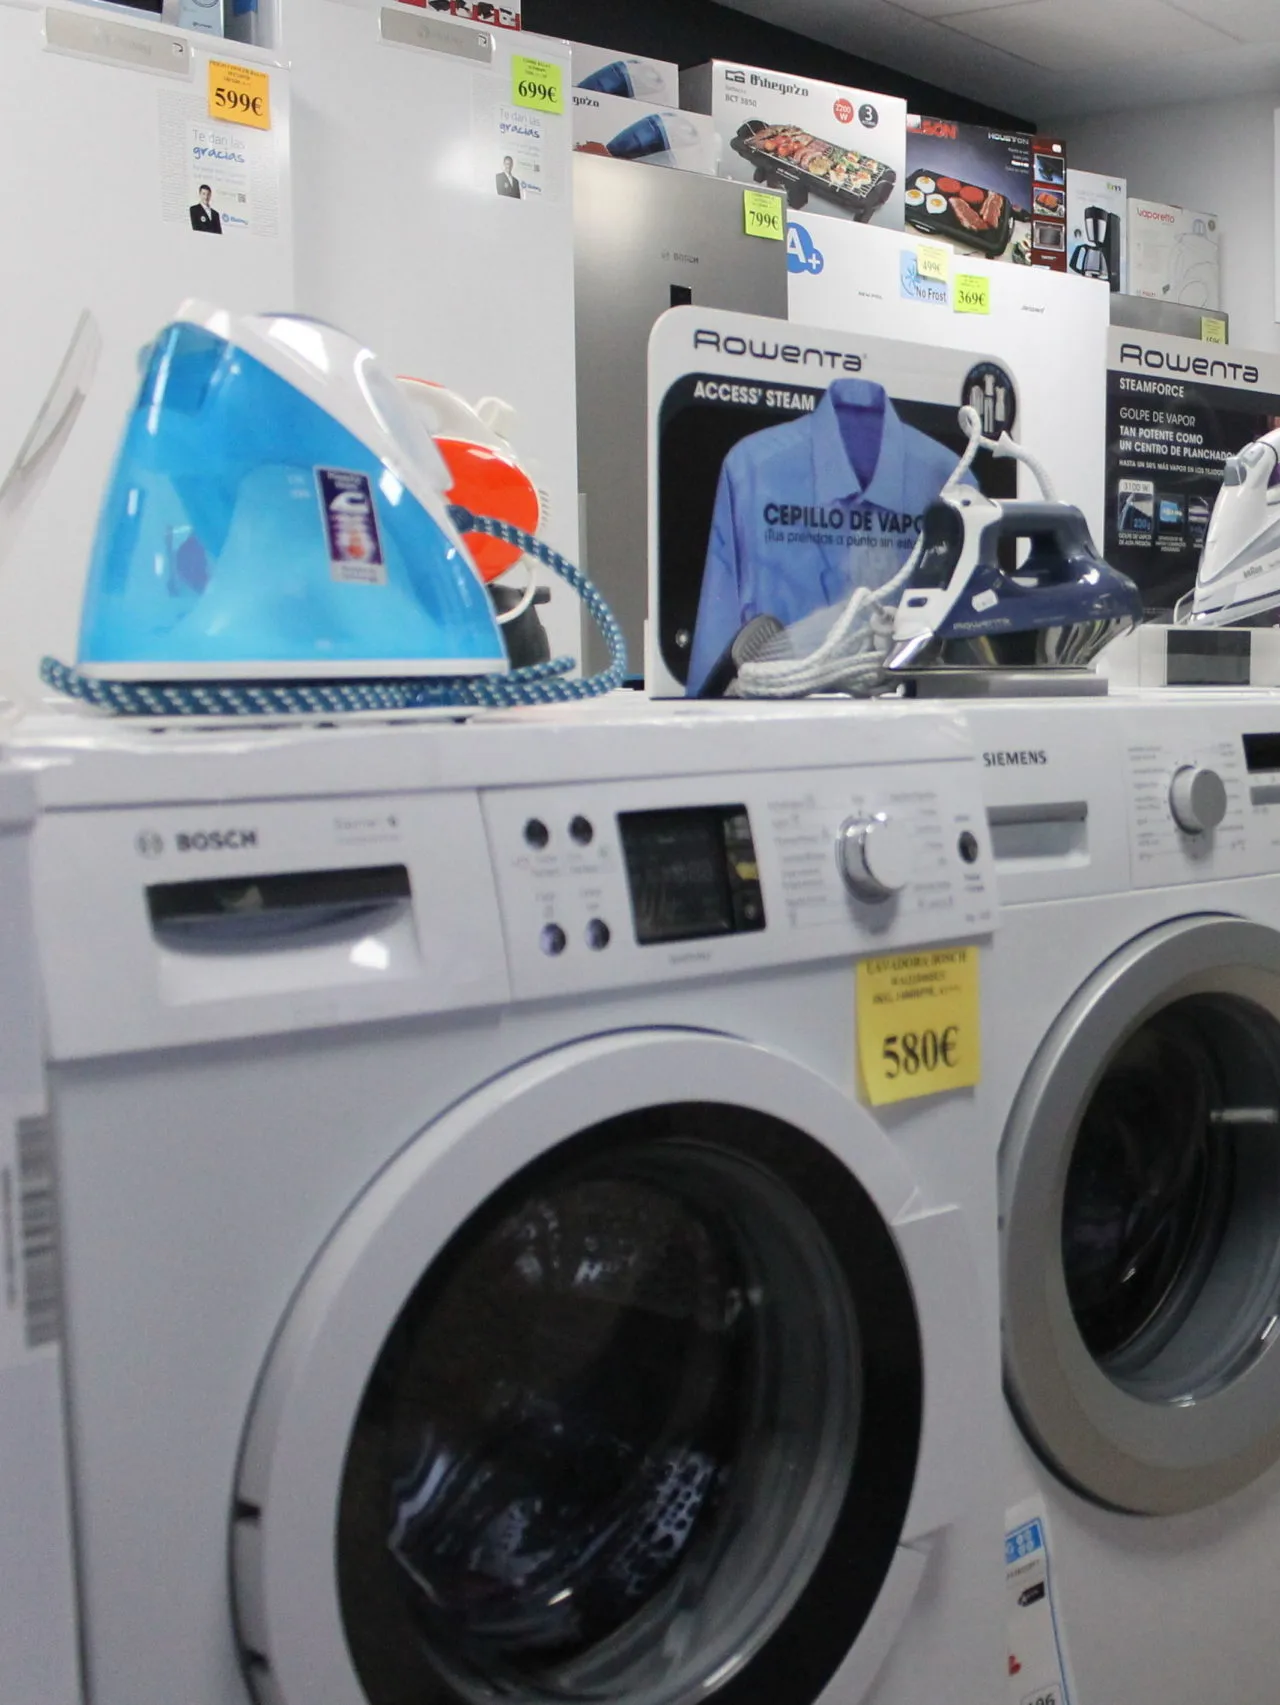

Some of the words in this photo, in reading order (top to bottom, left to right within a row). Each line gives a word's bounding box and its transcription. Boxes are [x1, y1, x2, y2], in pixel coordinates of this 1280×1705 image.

[518, 80, 558, 104] 699€
[572, 96, 600, 107] gozo
[214, 87, 264, 117] 599€
[835, 103, 851, 115] 2200
[840, 112, 849, 121] W
[863, 106, 873, 122] 3
[192, 129, 206, 142] Te
[208, 131, 229, 146] dan
[231, 132, 246, 149] las
[499, 122, 541, 139] gracias
[987, 132, 1029, 145] HOUSTON
[192, 146, 245, 163] gracias
[749, 210, 779, 231] 799€
[922, 260, 941, 275] 499€
[915, 286, 927, 299] No
[927, 287, 947, 303] Frost
[958, 289, 986, 307] 369€
[693, 328, 863, 373] Rowenta
[1120, 343, 1259, 384] Rowenta
[1119, 377, 1185, 398] STEAMFORCE
[765, 389, 815, 411] STEAM
[1119, 407, 1150, 422] GOLPE
[1152, 410, 1164, 423] DE
[1166, 412, 1196, 427] VAPOR
[1119, 425, 1136, 437] TAN
[1138, 427, 1174, 442] POTENTE
[1176, 431, 1204, 445] COMO
[1119, 440, 1132, 450] UN
[1134, 441, 1168, 455] CENTRO
[1170, 446, 1181, 457] DE
[763, 502, 845, 530] CEPILLO
[850, 509, 873, 532] DE
[878, 511, 925, 535] VAPO
[787, 531, 834, 547] prendas
[835, 535, 845, 546] a
[846, 534, 878, 550] punto
[880, 537, 894, 549] sin
[982, 749, 1047, 767] SIEMENS
[175, 828, 259, 853] BOSCH
[882, 1025, 961, 1079] 580€
